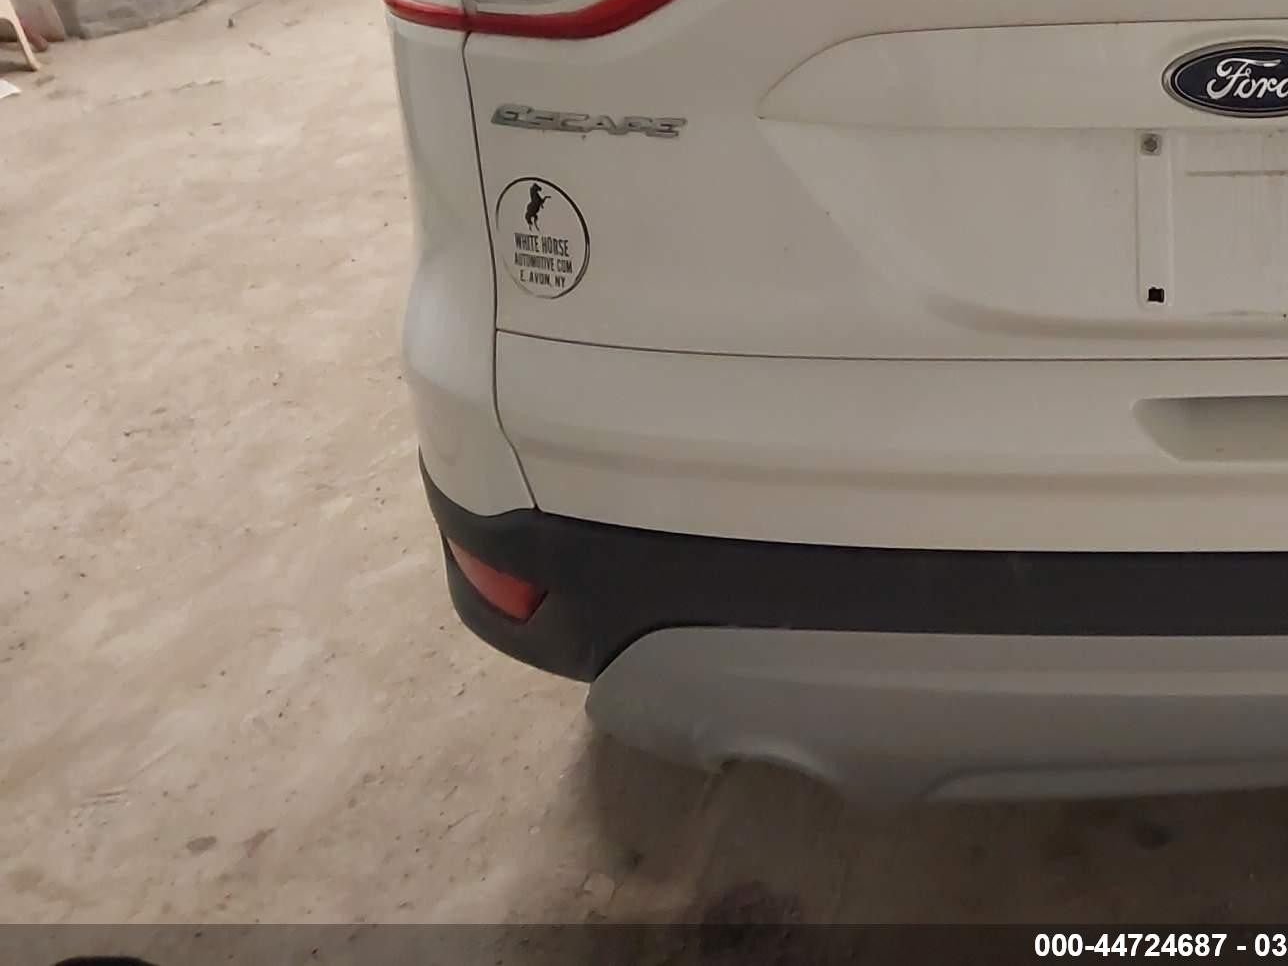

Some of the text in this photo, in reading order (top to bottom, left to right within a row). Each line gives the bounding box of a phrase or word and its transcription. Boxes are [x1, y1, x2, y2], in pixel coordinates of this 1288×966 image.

[490, 103, 687, 138] ESCAPE
[514, 232, 570, 257] WHITE HORSE
[554, 275, 566, 288] NY
